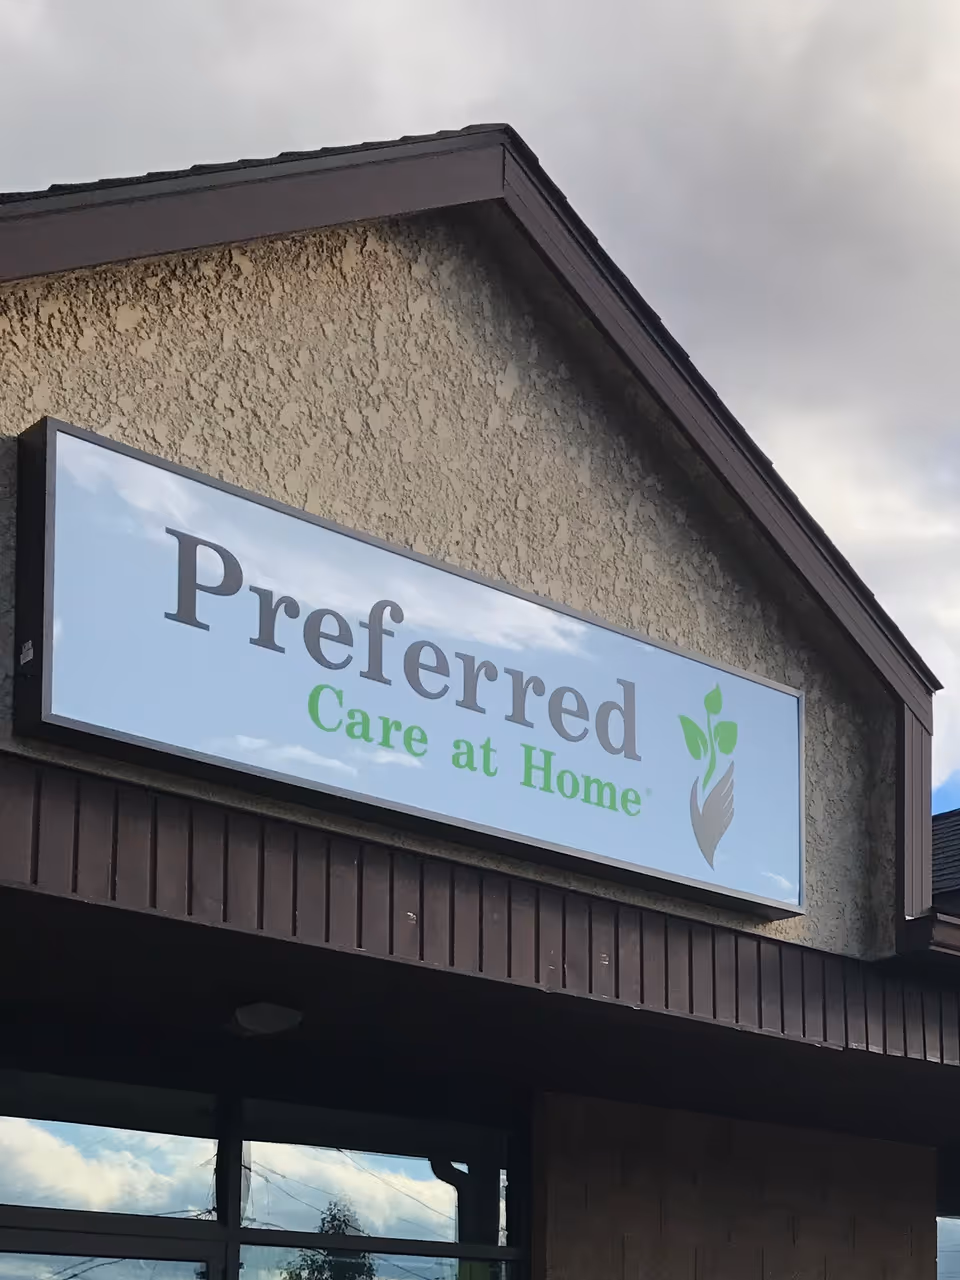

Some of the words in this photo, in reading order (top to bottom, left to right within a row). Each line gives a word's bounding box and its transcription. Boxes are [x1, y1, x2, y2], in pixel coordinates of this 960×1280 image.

[164, 527, 642, 762] Preferred
[307, 684, 428, 756] Care
[452, 737, 497, 777] at
[520, 743, 643, 817] Home
